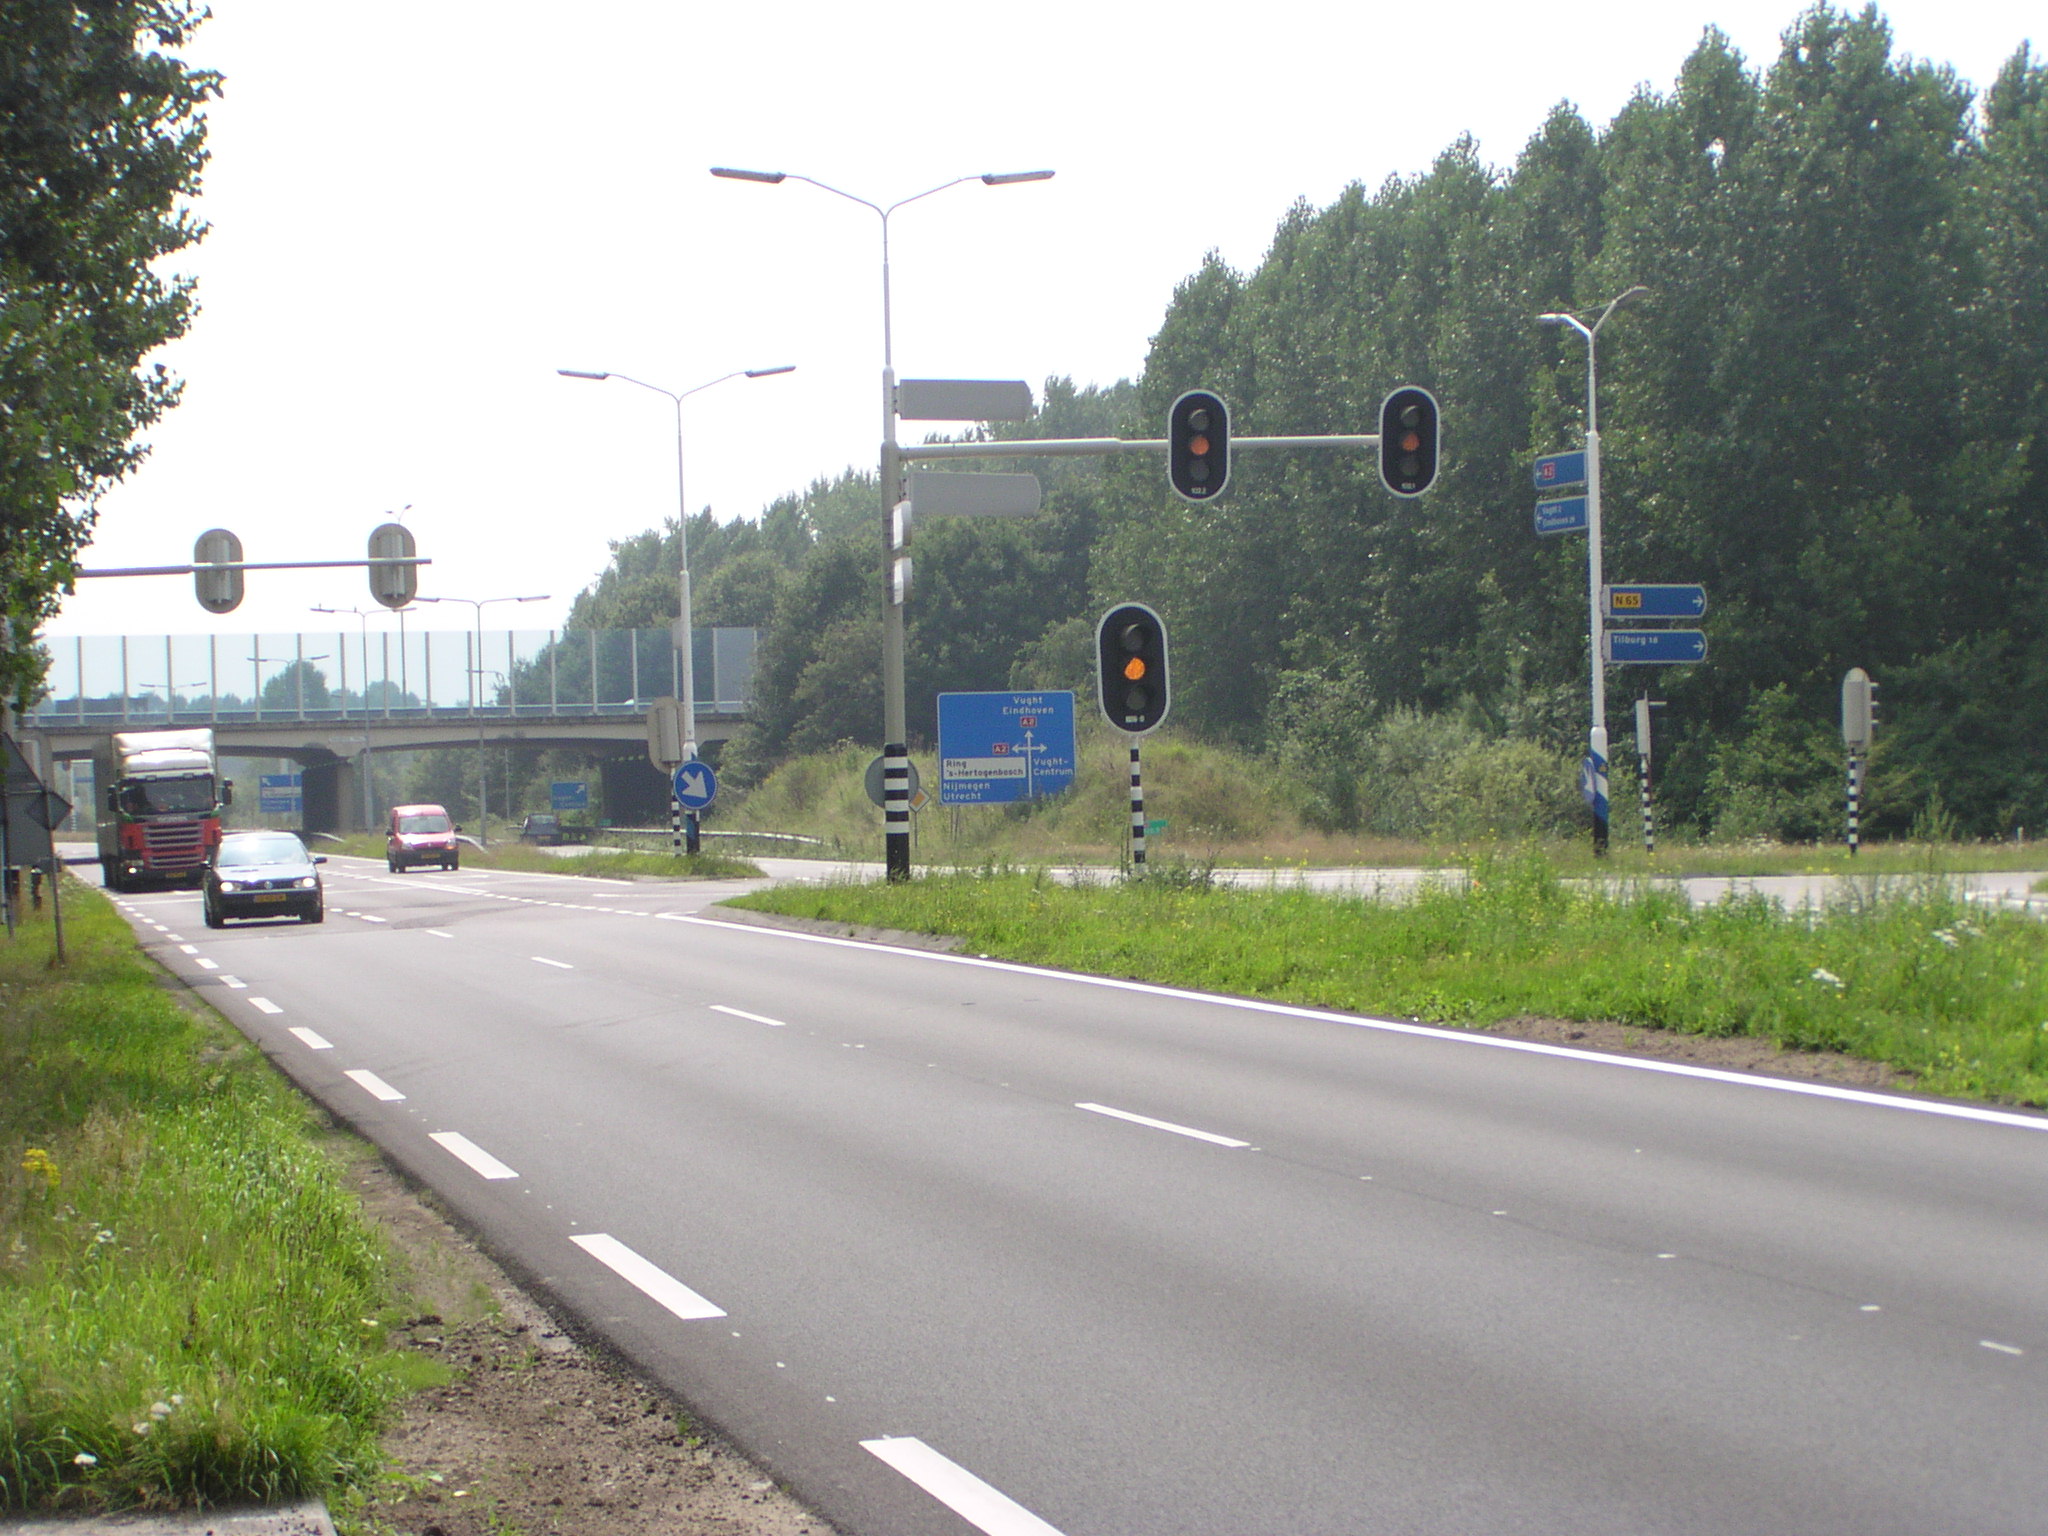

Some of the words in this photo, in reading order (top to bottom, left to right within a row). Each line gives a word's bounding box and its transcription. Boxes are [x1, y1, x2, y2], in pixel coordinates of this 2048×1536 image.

[1615, 595, 1623, 605] N
[1625, 595, 1639, 605] 65
[1613, 635, 1646, 646] Tilburg
[1013, 696, 1043, 706] Vught
[1002, 706, 1054, 715] Eindhoven
[994, 745, 1007, 753] A2
[946, 760, 967, 768] Ring
[1033, 758, 1069, 767] Vught-
[946, 768, 1024, 777] 's-Hertogenbosch
[1033, 768, 1073, 776] Centrum
[943, 782, 990, 791] Nijmegen
[943, 792, 981, 800] Utrecht
